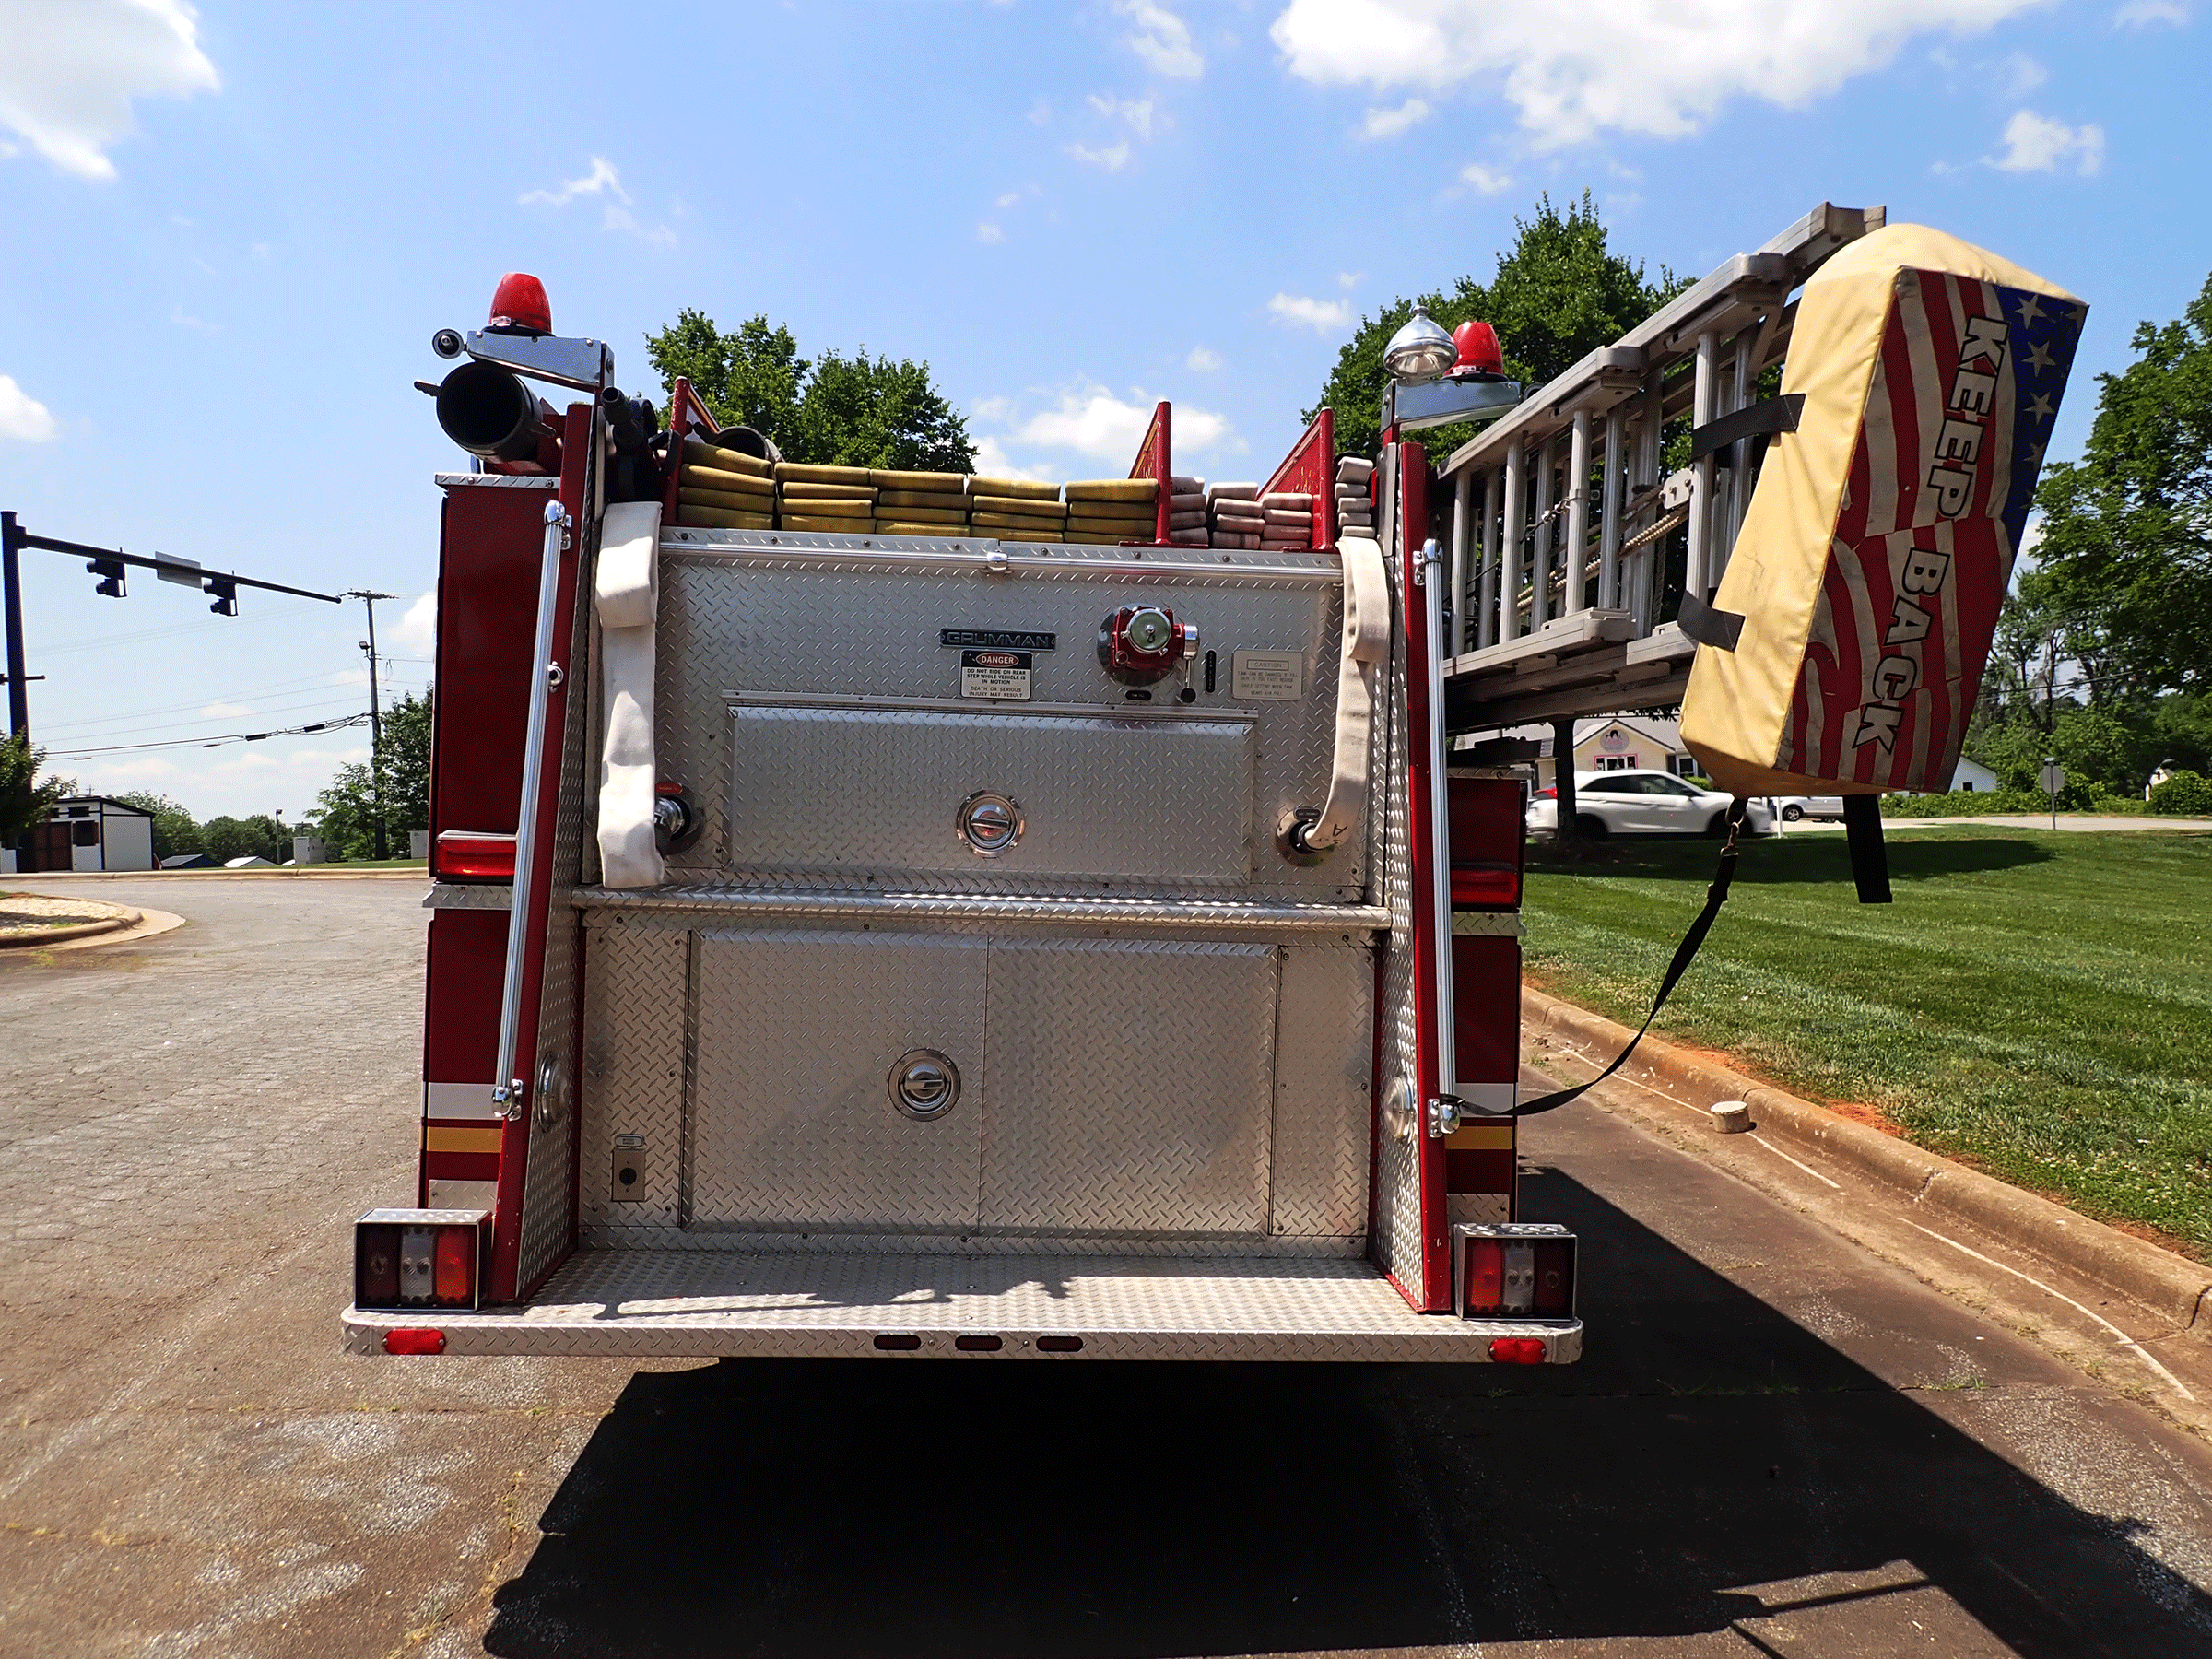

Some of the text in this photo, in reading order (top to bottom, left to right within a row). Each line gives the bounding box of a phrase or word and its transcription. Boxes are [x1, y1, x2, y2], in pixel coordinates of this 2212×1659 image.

[947, 631, 1049, 647] GRUMMAN
[1852, 314, 2011, 755] KEEP BACK
